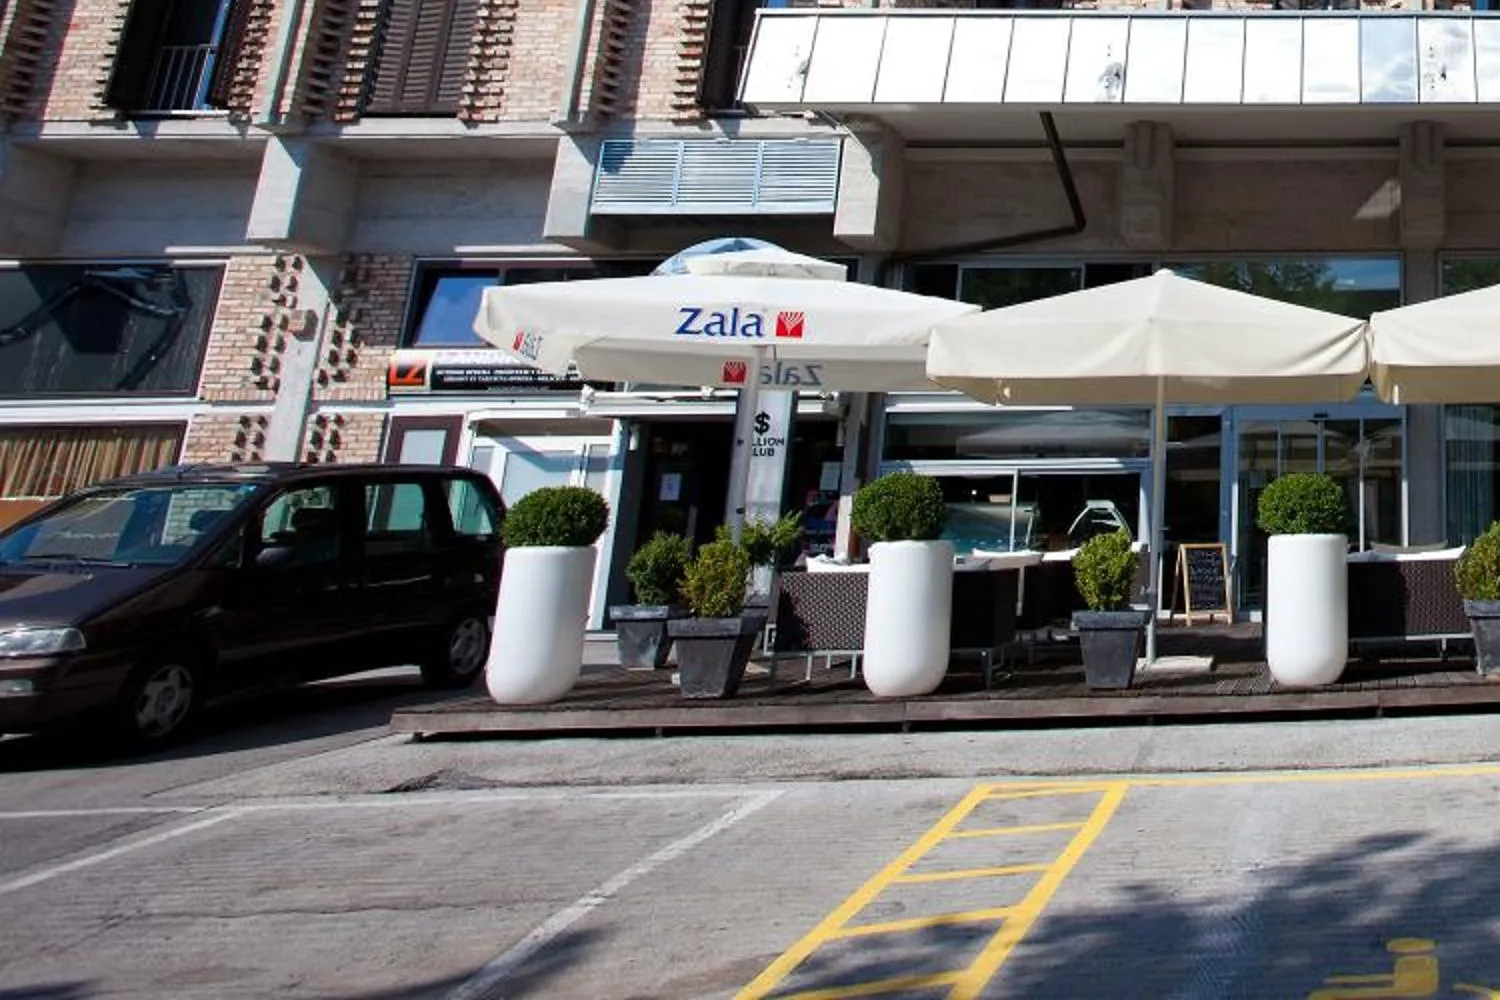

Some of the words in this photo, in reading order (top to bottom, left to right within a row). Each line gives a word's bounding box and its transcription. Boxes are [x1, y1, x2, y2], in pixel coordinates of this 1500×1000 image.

[675, 307, 764, 338] Zala
[752, 437, 785, 446] LLION
[753, 447, 775, 457] LUB
